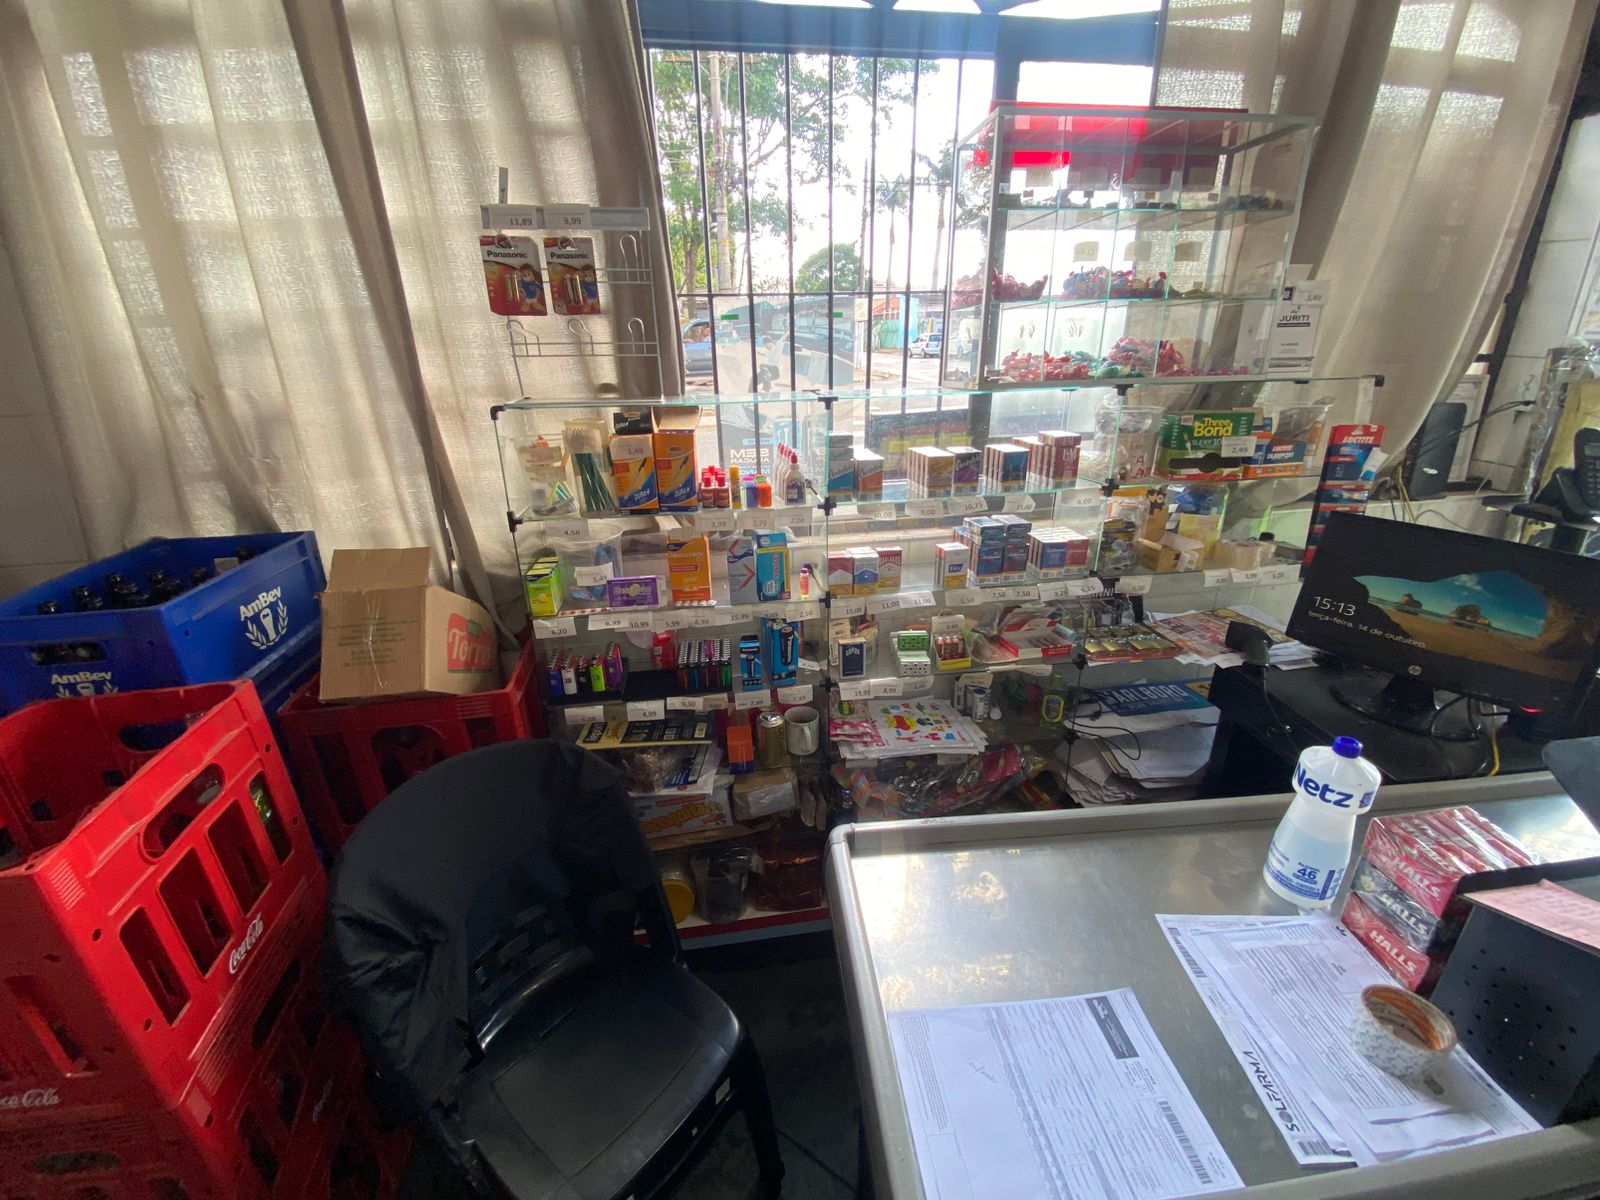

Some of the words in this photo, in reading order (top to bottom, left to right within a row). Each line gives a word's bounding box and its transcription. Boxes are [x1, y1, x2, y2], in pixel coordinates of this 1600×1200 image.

[509, 217, 533, 226] 11,89
[563, 216, 582, 225] 9,99
[487, 250, 528, 259] Panasonic
[550, 251, 589, 260] Panasonic
[1279, 314, 1310, 322] JURITI
[1202, 417, 1232, 427] Three
[1193, 422, 1233, 437] Bond
[1342, 435, 1375, 444] LOCTITE
[239, 586, 282, 622] AmBev
[1314, 596, 1356, 616] 15:13
[1358, 623, 1368, 632] 14
[1369, 627, 1383, 636] de
[1385, 632, 1426, 648] outubro
[51, 671, 112, 685] AmBev
[1294, 762, 1354, 808] Netz
[1297, 867, 1317, 880] 46
[1393, 855, 1441, 898] HALLS
[1380, 892, 1428, 935] HALLS
[1369, 929, 1418, 974] HALLS
[1243, 1050, 1301, 1133] SOLFARMA
